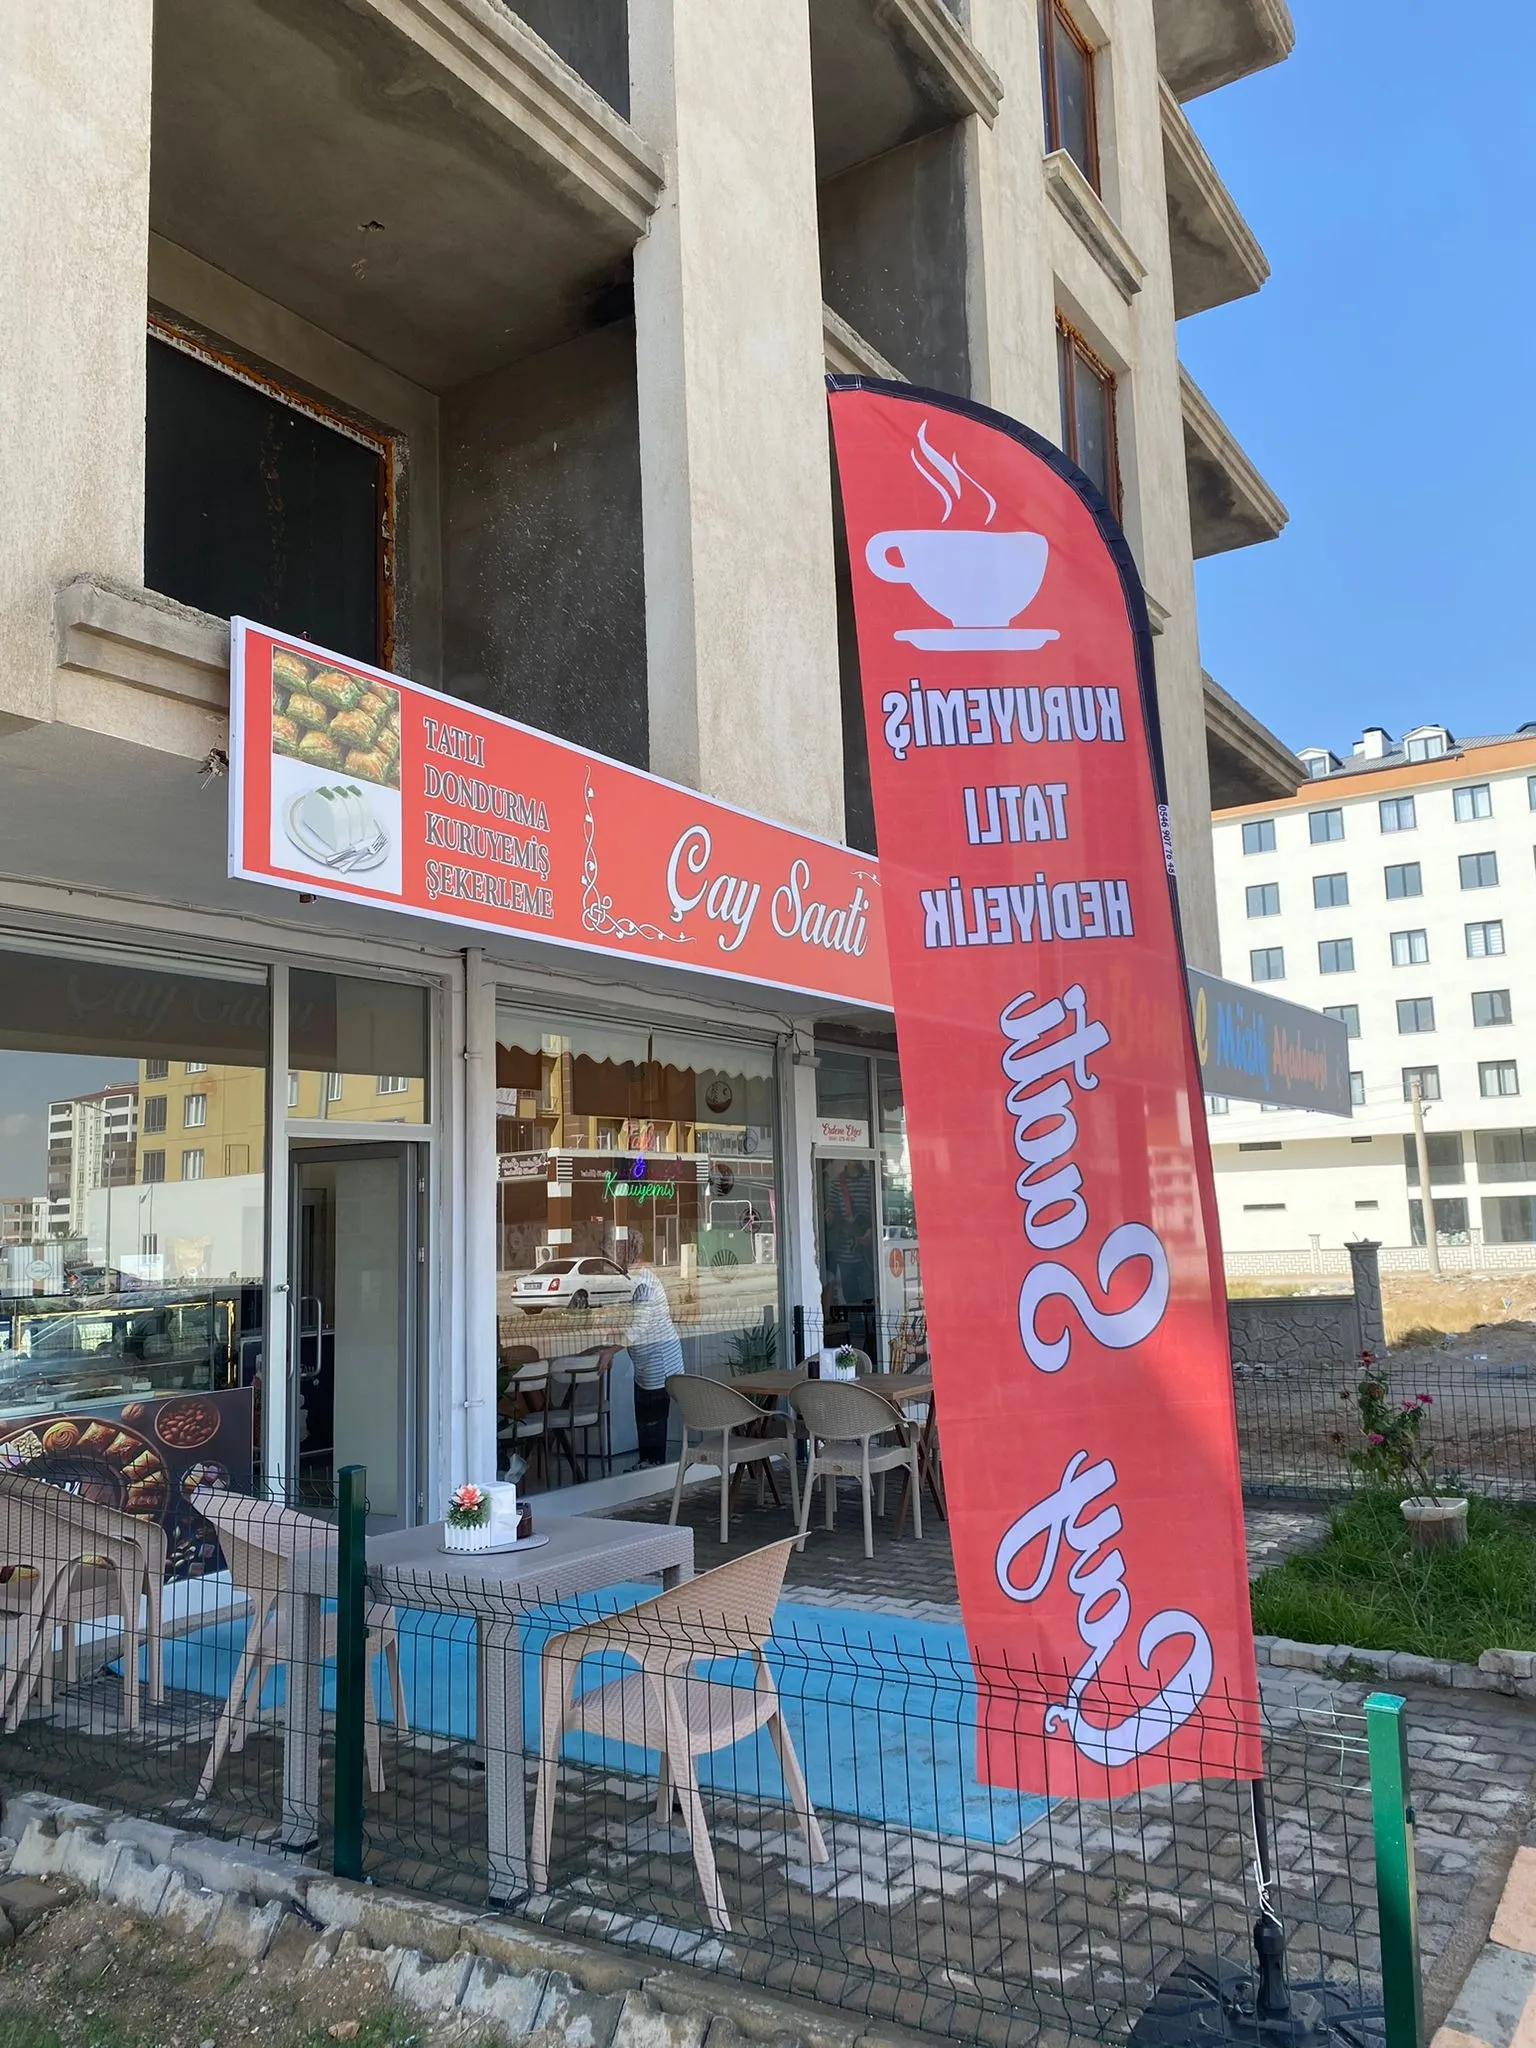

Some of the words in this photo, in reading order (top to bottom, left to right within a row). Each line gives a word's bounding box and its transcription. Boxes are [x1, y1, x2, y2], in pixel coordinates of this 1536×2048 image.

[423, 716, 484, 767] TATLI
[424, 764, 550, 832] DONDURMA
[1159, 805, 1169, 828] 0546
[425, 811, 550, 880] KURUYEMİŞ
[1163, 830, 1172, 847] 907
[425, 859, 554, 919] ŞEKERLEME
[666, 824, 760, 951] Çay
[771, 859, 869, 957] Saati
